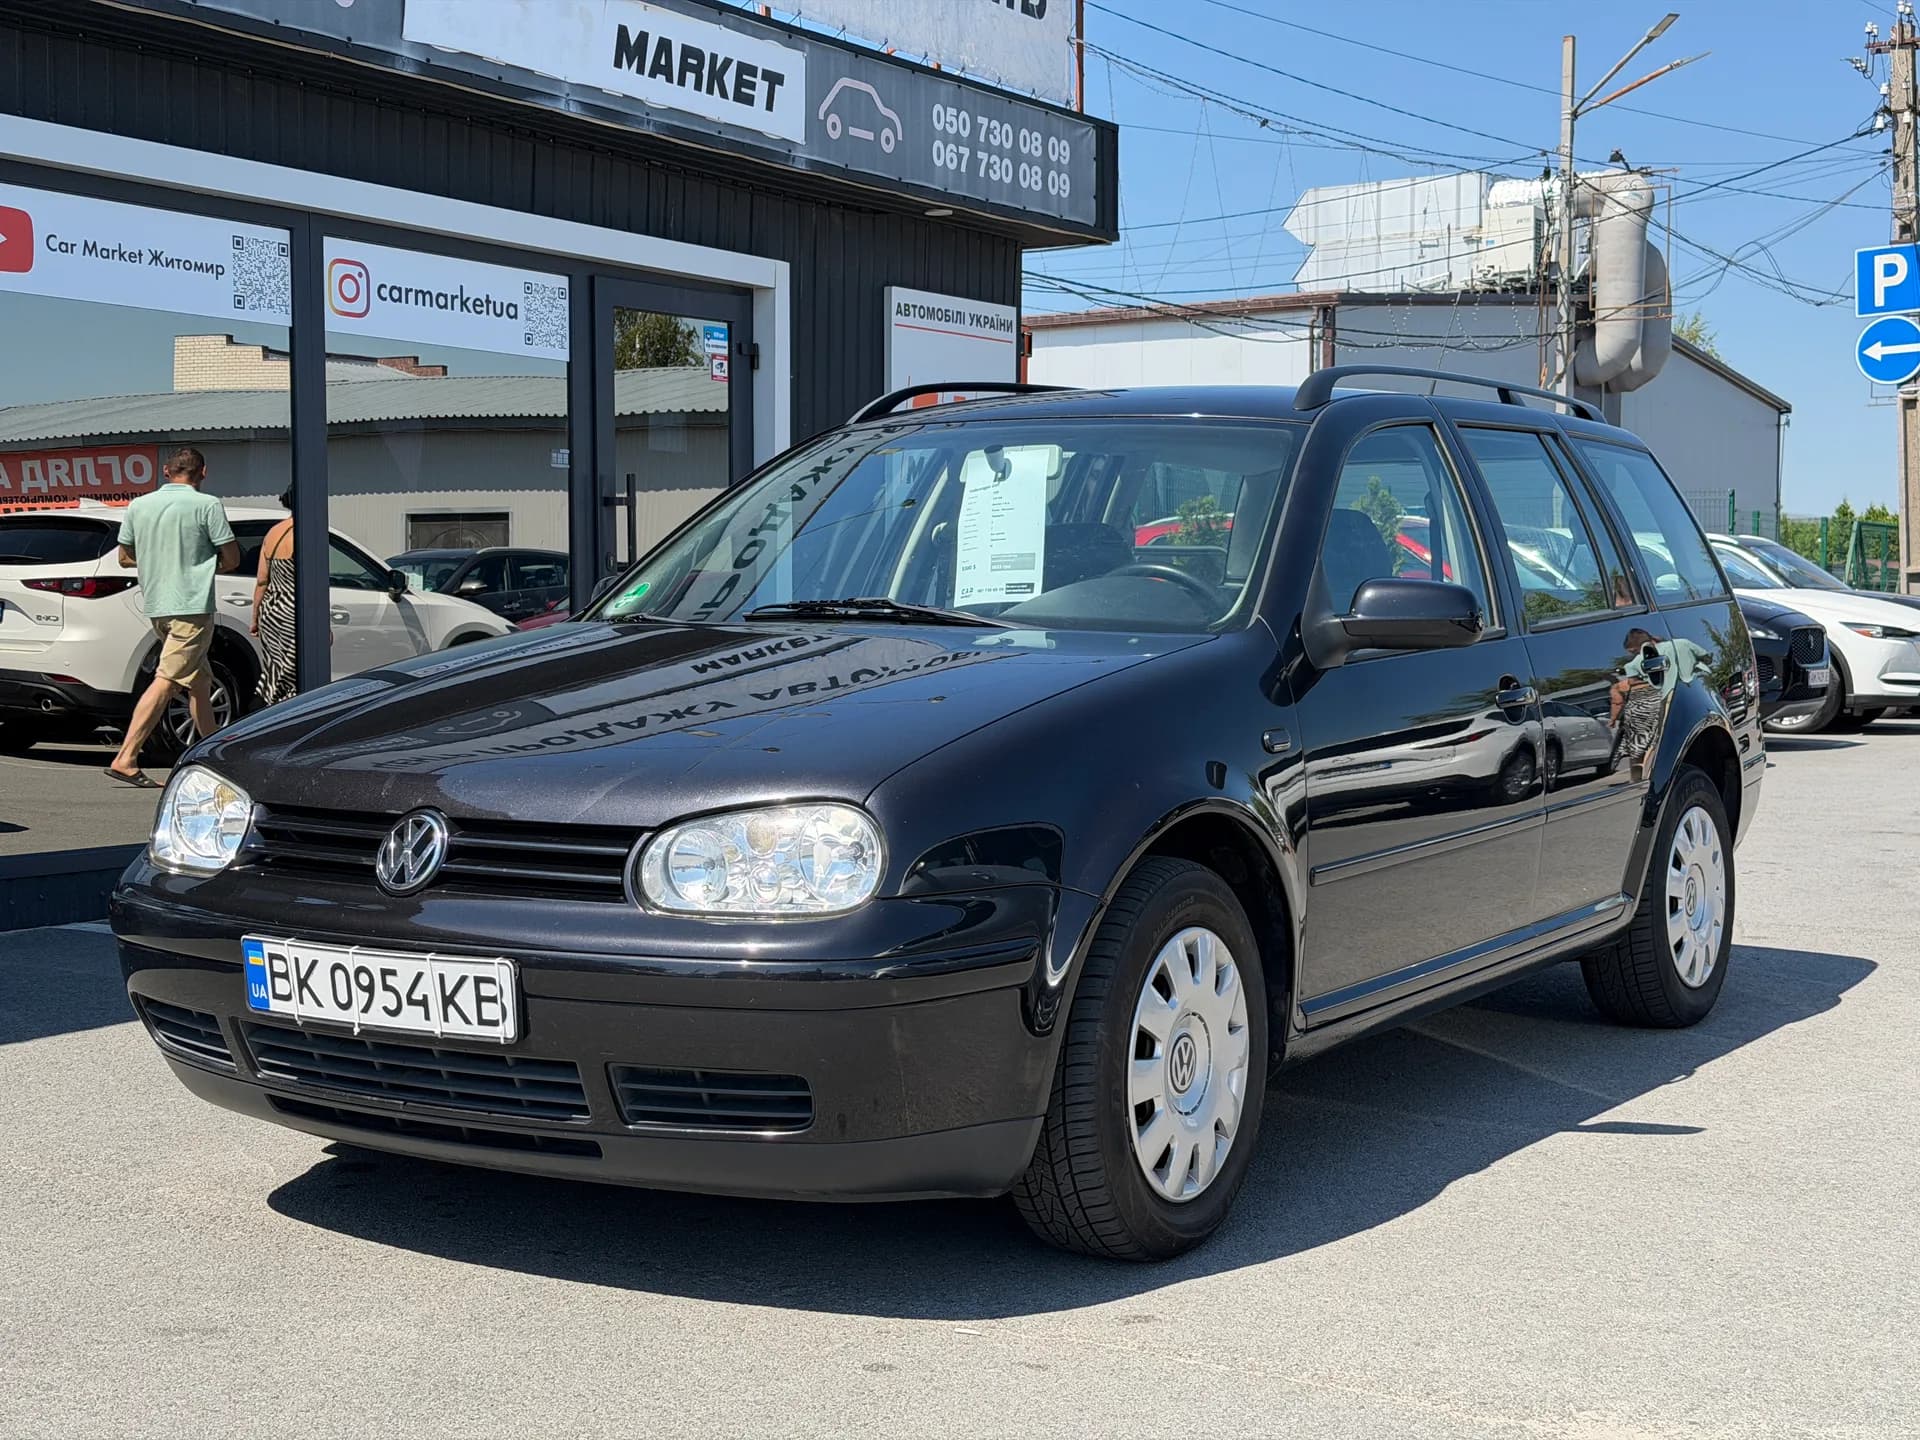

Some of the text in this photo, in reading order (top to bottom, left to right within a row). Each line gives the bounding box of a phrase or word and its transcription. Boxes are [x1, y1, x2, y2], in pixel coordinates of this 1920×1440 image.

[613, 23, 785, 113] MARKET
[932, 103, 1071, 165] 050 730 08 09
[932, 140, 1071, 198] 067 730 08 09
[45, 234, 226, 281] Car Market Житомир
[1874, 253, 1908, 308] P
[376, 284, 519, 321] carmarketua
[895, 302, 1013, 334] АВТОМОБІЛІ УКРАЇНИ
[252, 982, 268, 999] UA
[268, 952, 508, 1028] BK 0954 KB
